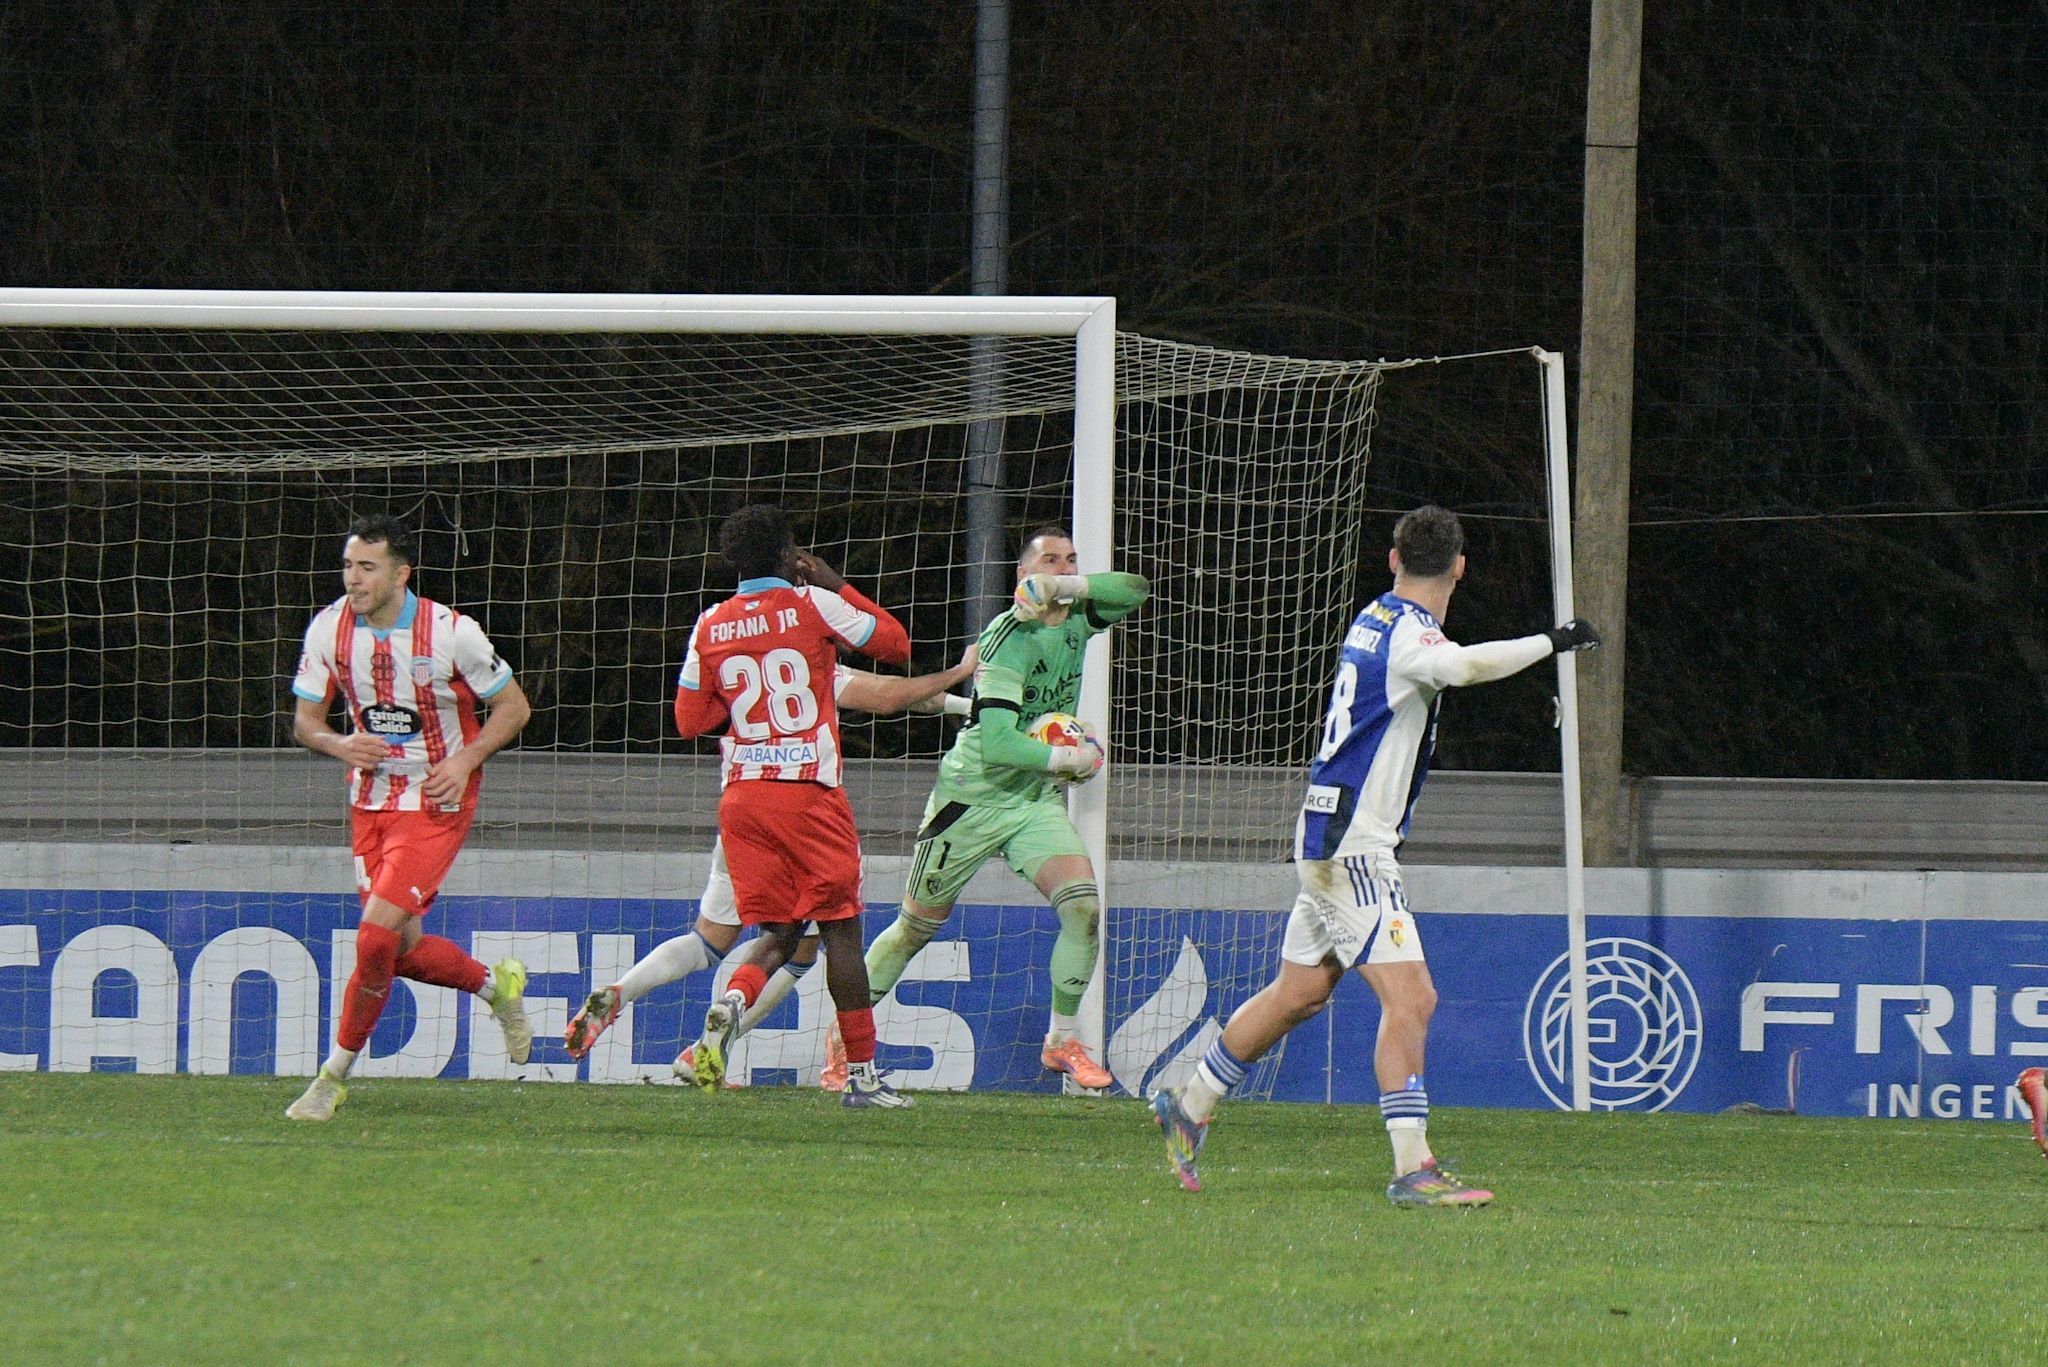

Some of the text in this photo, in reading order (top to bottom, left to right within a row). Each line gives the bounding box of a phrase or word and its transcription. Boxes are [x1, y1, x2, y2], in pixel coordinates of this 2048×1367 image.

[710, 607, 800, 644] FOFANA JR
[719, 647, 819, 740] 28
[371, 720, 412, 733] Galicia
[743, 744, 813, 763] ABANCA
[937, 841, 951, 869] 1
